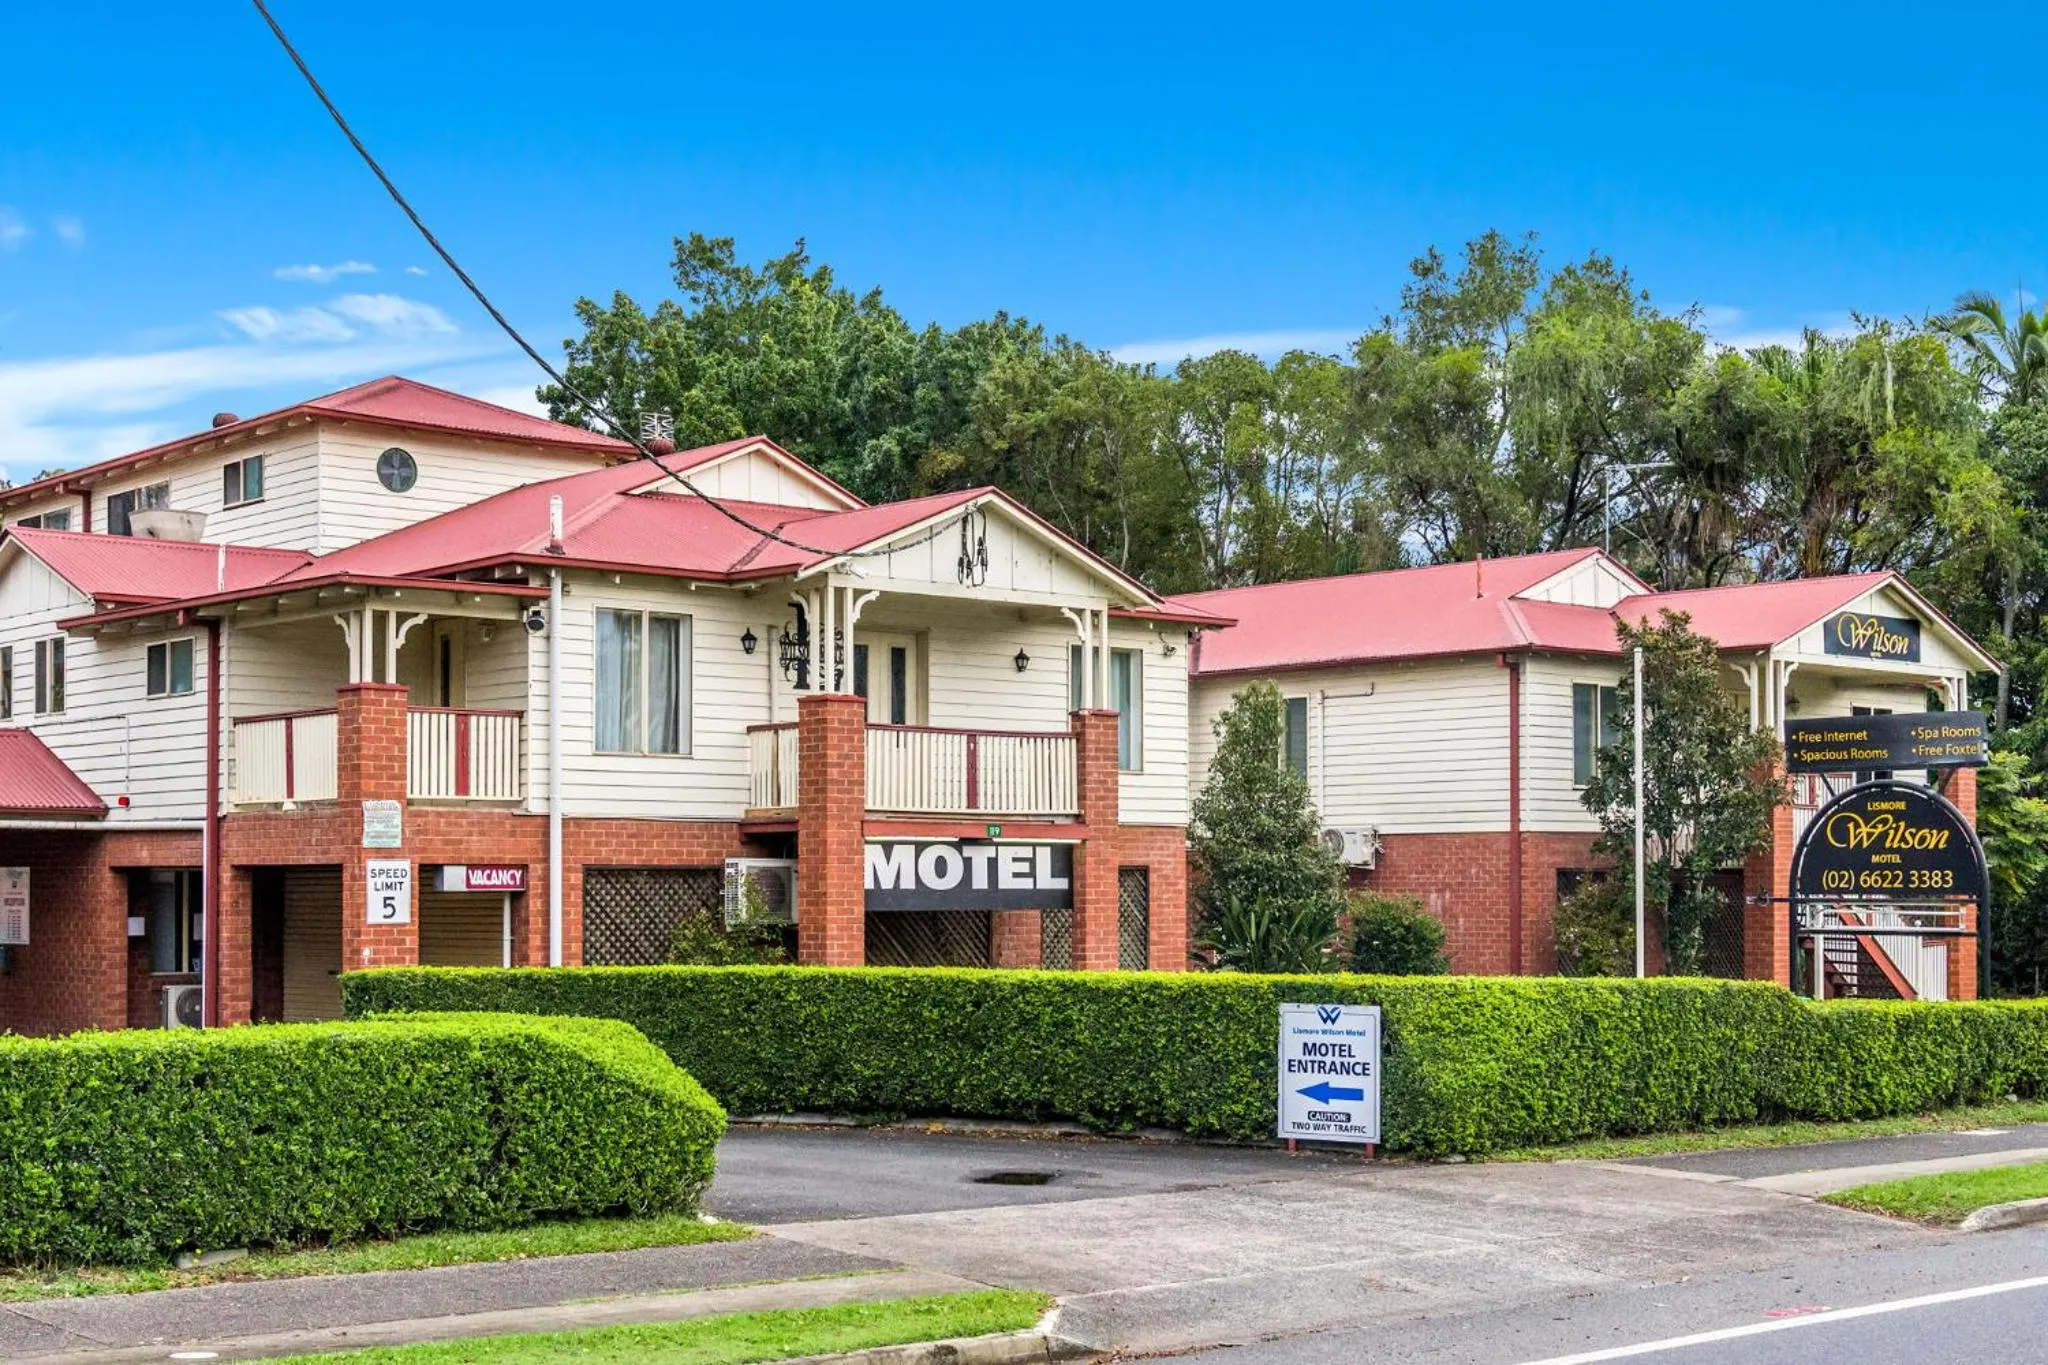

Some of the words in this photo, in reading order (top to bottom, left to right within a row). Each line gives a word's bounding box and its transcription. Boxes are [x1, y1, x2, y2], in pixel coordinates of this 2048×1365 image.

[1837, 613, 1909, 655] Wilson
[1798, 732, 1822, 743] Free
[1824, 729, 1868, 742] Internet
[1918, 727, 1939, 739] Spa
[1942, 726, 1982, 738] Rooms
[1800, 750, 1848, 762] Spacious
[1851, 748, 1889, 759] Rooms
[1918, 745, 1943, 756] Free
[1946, 742, 1981, 755] Foxtel
[1867, 801, 1907, 811] LISMORE
[1826, 812, 1950, 850] Wilson
[1871, 854, 1903, 864] MOTEL
[370, 868, 408, 879] SPEED
[864, 844, 1069, 890] MOTEL
[468, 869, 523, 886] VACANCY
[1822, 870, 1855, 890] (02)
[1860, 870, 1903, 889] 6622
[1909, 870, 1953, 889] 3383
[373, 881, 405, 892] LIMIT
[382, 896, 397, 920] 5
[1302, 1042, 1356, 1059] MOTEL
[1287, 1058, 1371, 1077] ENTRANCE
[1292, 1121, 1311, 1131] TWO
[1313, 1123, 1331, 1132] WAY
[1334, 1124, 1367, 1134] TRAFFIC
